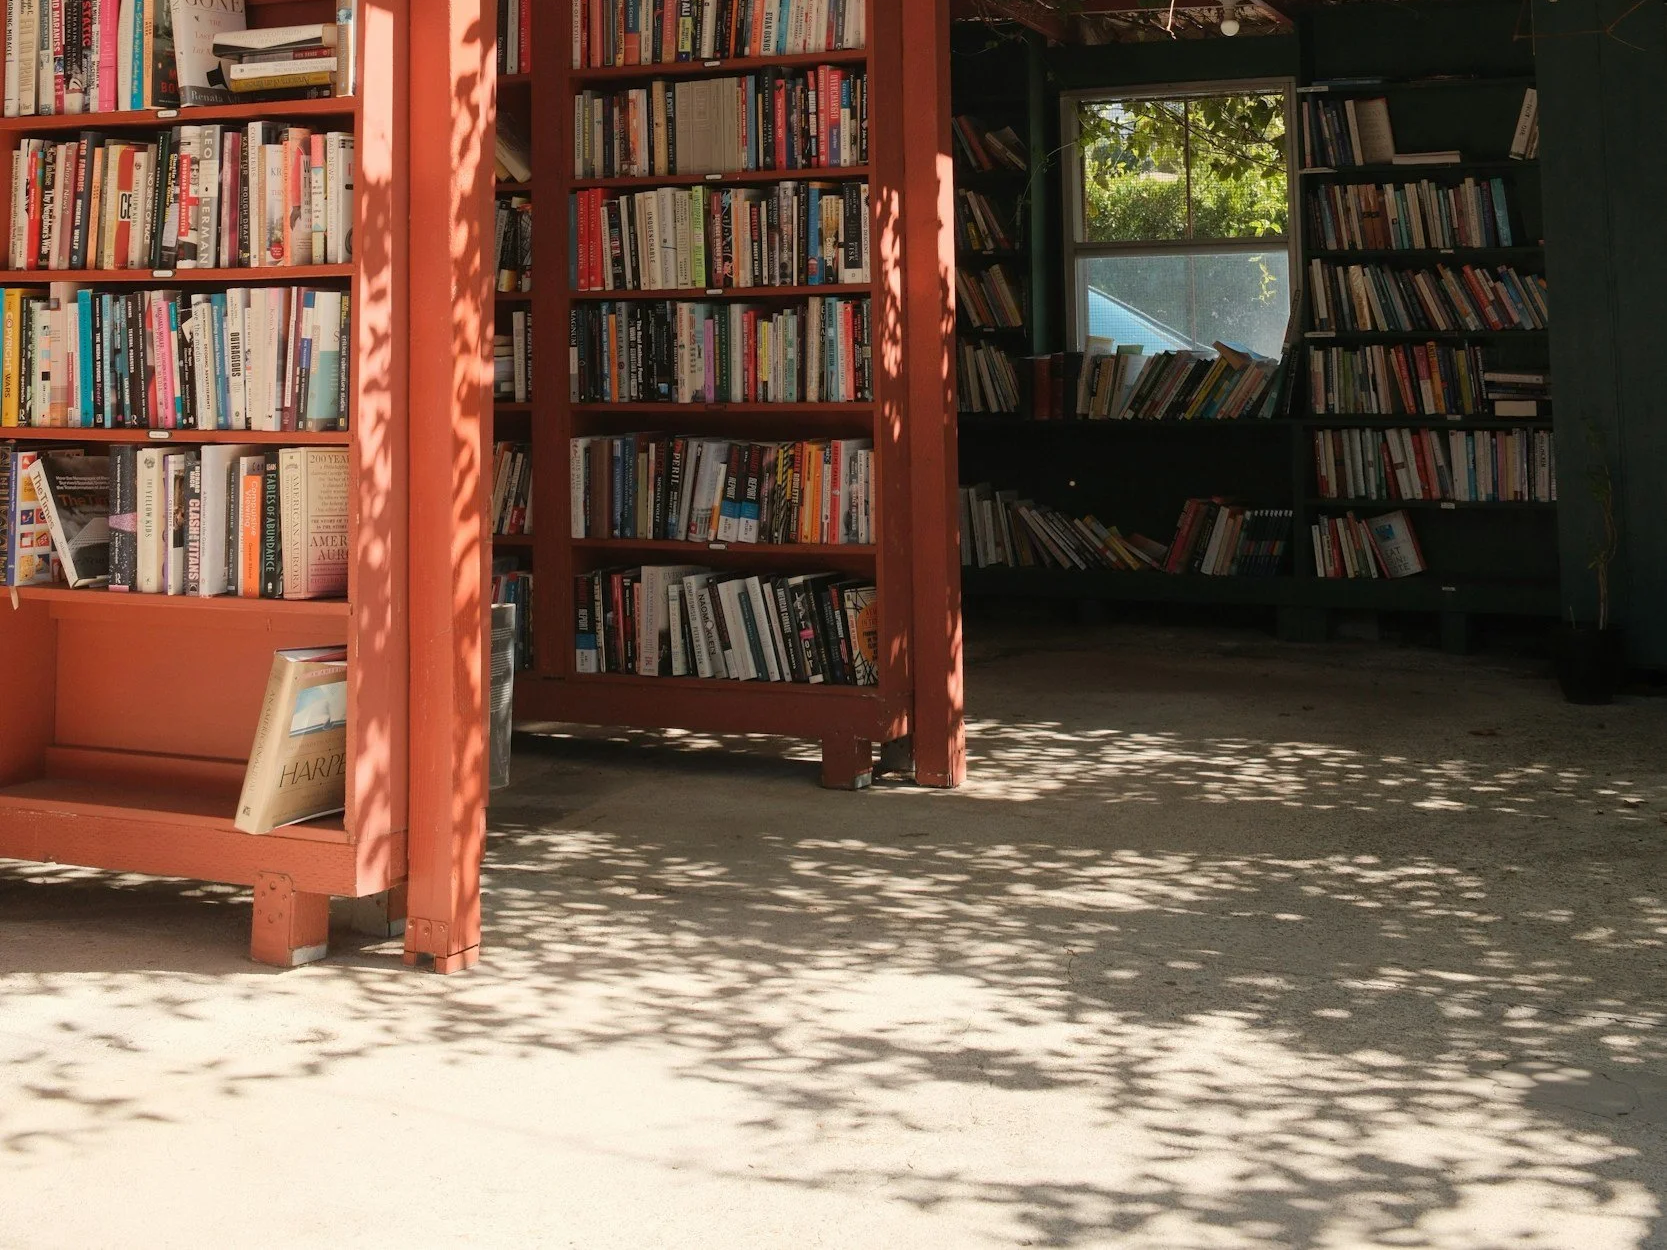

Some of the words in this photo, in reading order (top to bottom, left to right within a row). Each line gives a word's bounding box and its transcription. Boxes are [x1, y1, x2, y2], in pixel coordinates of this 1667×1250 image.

[682, 2, 691, 16] ALI
[765, 12, 773, 30] EVAN
[82, 0, 91, 46] STATIC
[763, 30, 772, 52] OSNOS
[191, 90, 224, 103] Renata
[46, 150, 56, 163] Gay
[204, 130, 212, 158] LEO
[45, 165, 55, 185] Talese
[77, 159, 85, 192] FAMOUS
[147, 173, 153, 185] NO
[44, 189, 54, 202] Thy
[62, 190, 70, 215] News?
[42, 204, 53, 238] Neighbor's
[145, 213, 151, 222] OF
[199, 198, 211, 263] LERMAN
[41, 239, 51, 254] Wife
[647, 211, 655, 263] UNQUENCHABLE
[4, 312, 13, 372] COPYRIGHT
[230, 332, 241, 377] OUTRAGEOUS
[671, 452, 681, 486] PERIL
[32, 471, 44, 493] The
[40, 496, 55, 530] Times
[266, 474, 277, 504] FABLES
[727, 477, 737, 499] REPORT
[747, 477, 758, 500] REPORT
[145, 491, 153, 517] YELLOW
[189, 499, 200, 534] CLASH
[267, 506, 273, 516] OF
[145, 520, 153, 538] KIDS
[265, 518, 275, 572] ABUNDANCE
[188, 542, 200, 580] TITANS
[292, 540, 300, 589] AURORA
[578, 609, 588, 630] REPORT
[705, 629, 716, 656] KLEIN
[279, 752, 347, 788] HARPE
